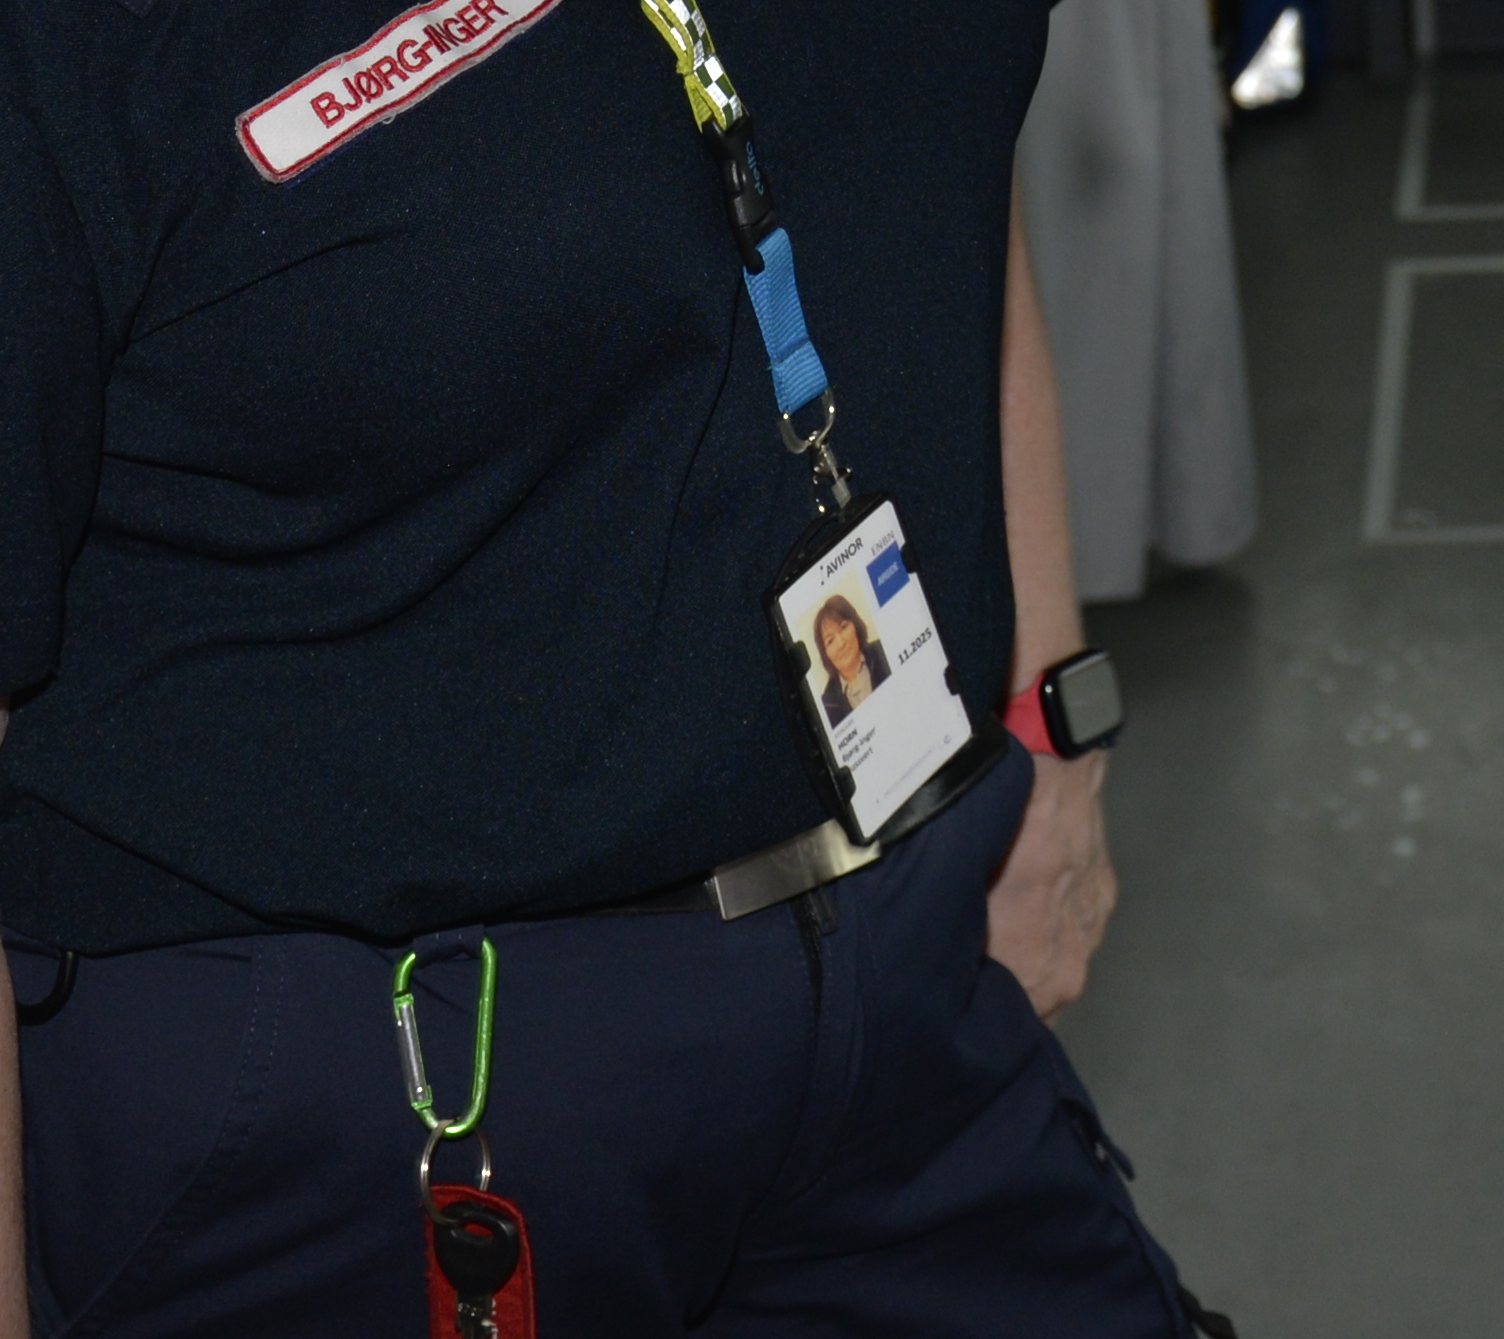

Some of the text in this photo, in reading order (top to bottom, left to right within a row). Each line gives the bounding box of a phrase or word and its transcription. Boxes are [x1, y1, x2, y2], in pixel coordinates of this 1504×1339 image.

[826, 536, 864, 578] AVINOR
[898, 627, 933, 665] 11.2025
[837, 728, 858, 751] HORN
